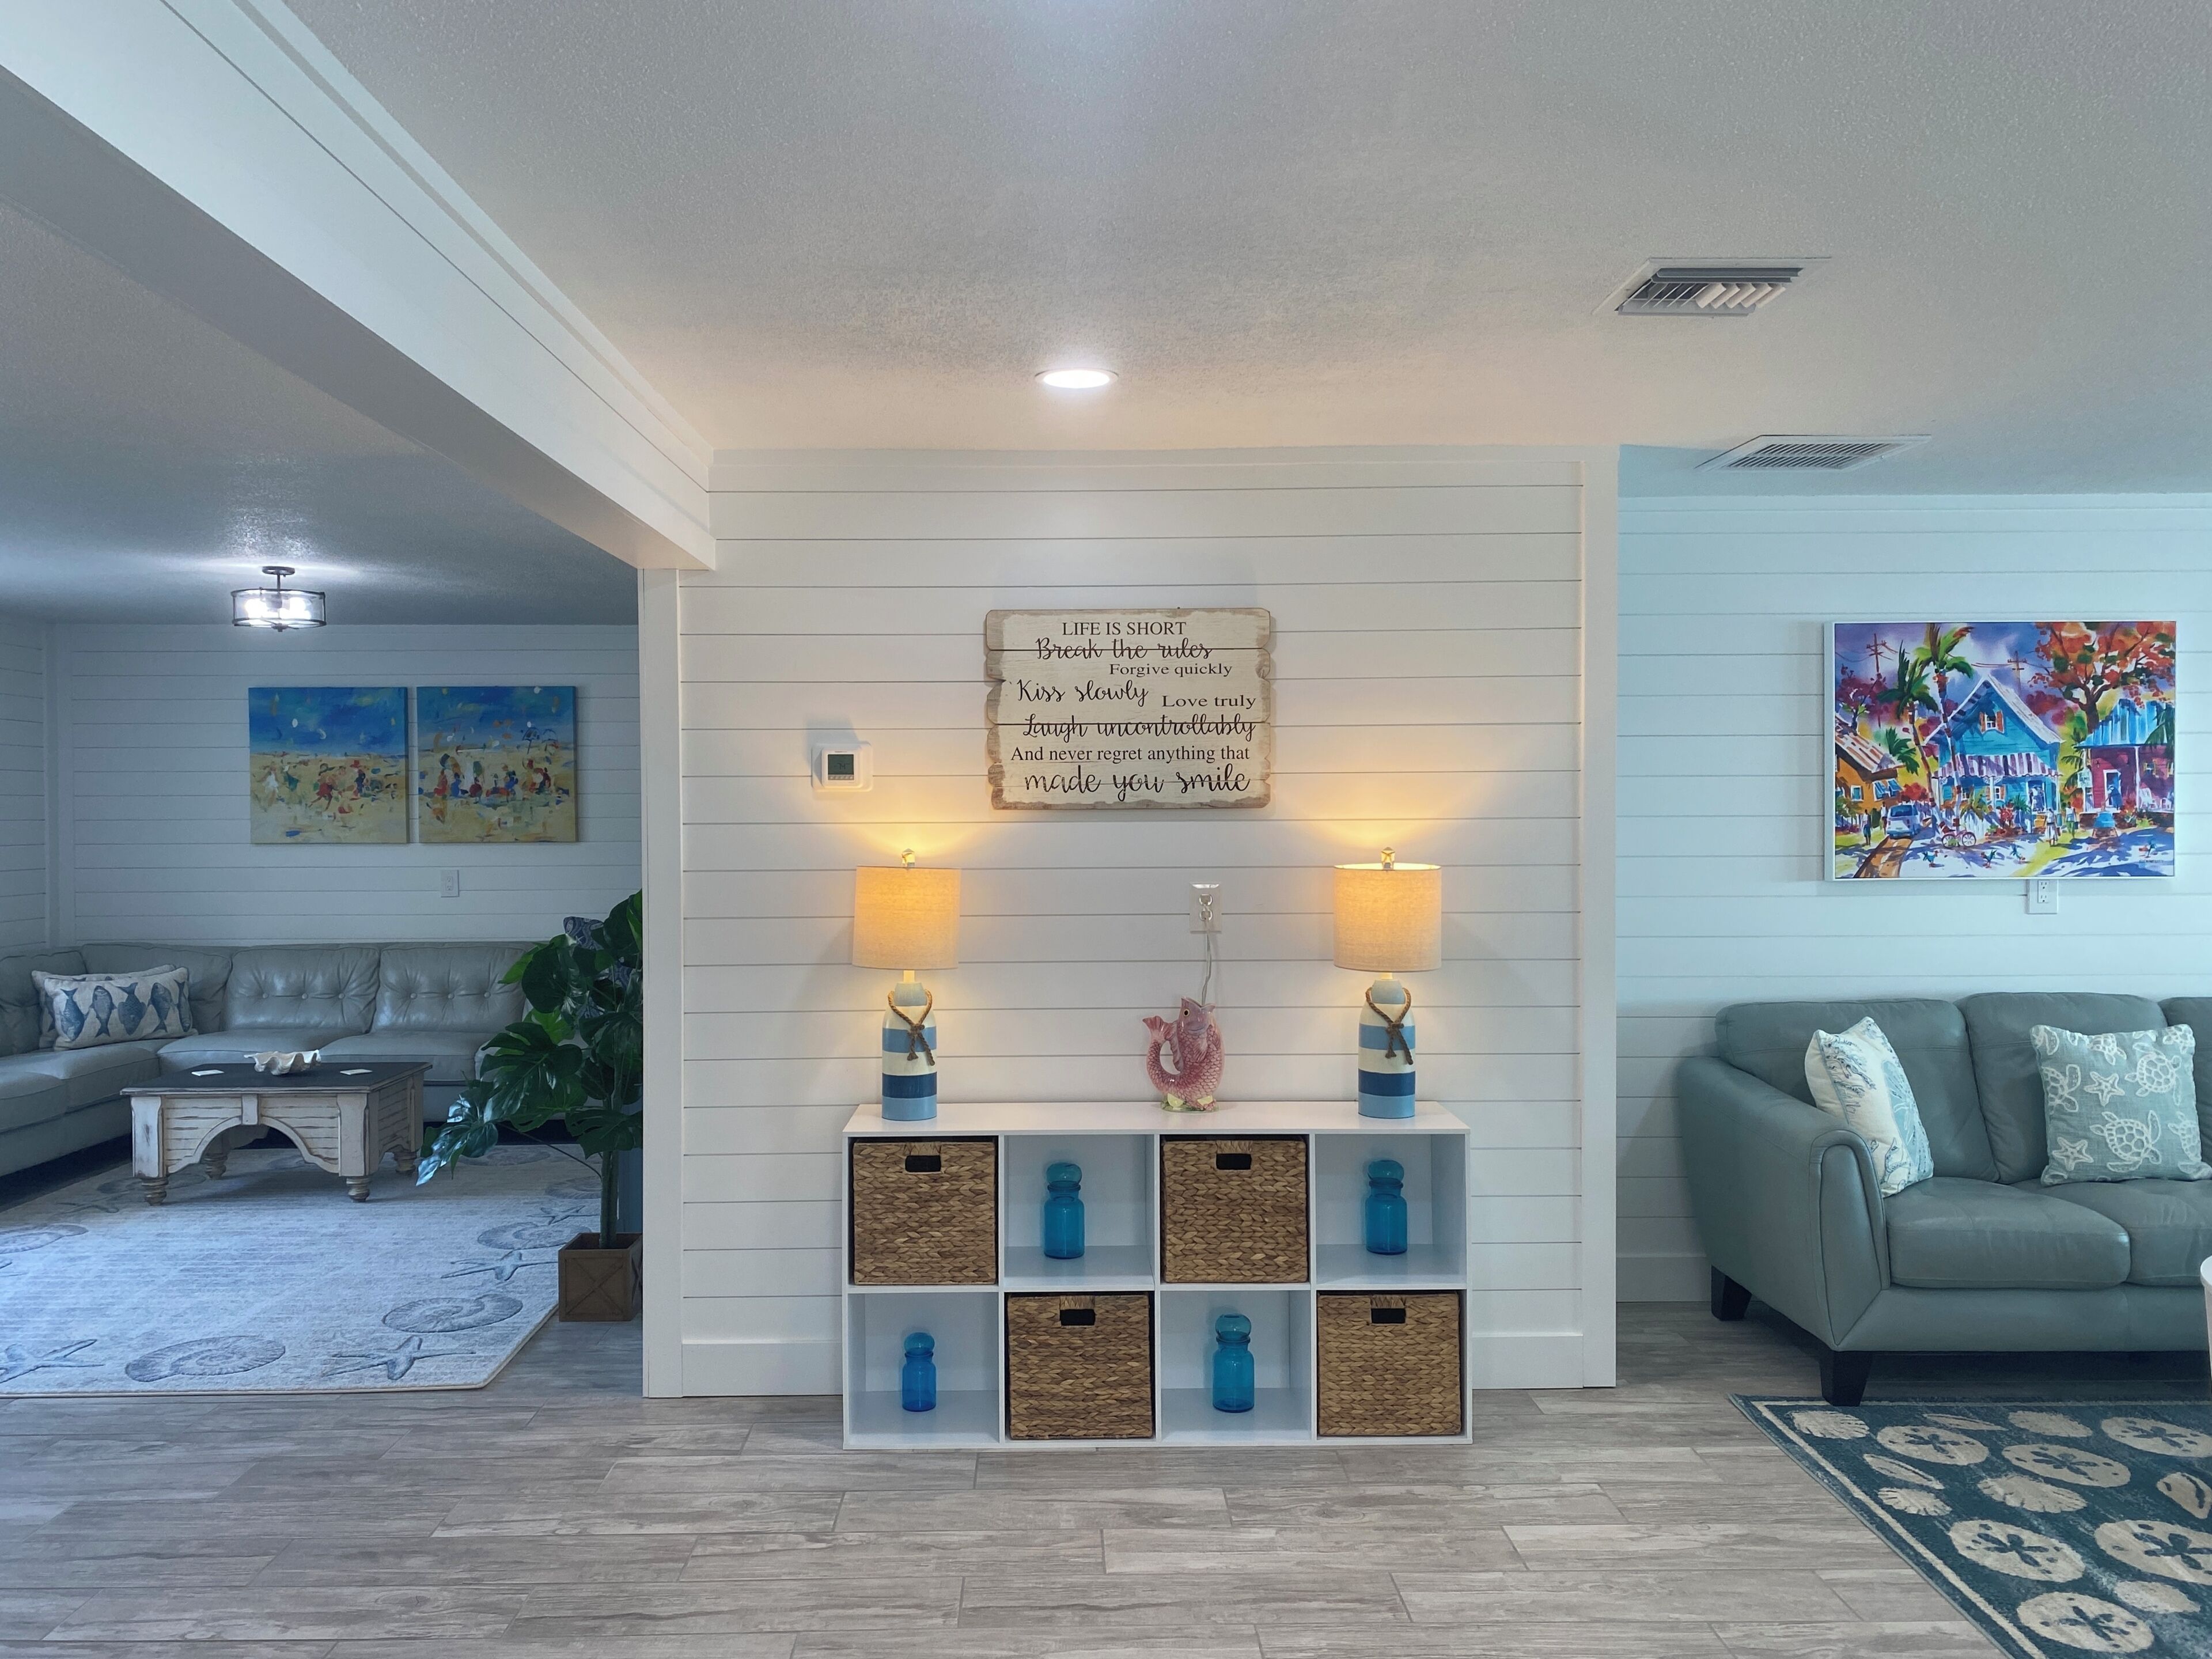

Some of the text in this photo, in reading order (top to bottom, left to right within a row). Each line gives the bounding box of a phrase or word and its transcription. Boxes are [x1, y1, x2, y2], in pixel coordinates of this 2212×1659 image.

[1062, 622, 1187, 635] LIFE IS SHORT
[1036, 638, 1212, 660] Break the rules
[1109, 663, 1232, 677] Forgive quickly
[1017, 679, 1149, 707] Kiss slowly
[1162, 695, 1256, 709] Love truly
[1023, 714, 1256, 743] Laugh uncontrollably
[1011, 746, 1250, 763] And never regret anything that
[1025, 763, 1251, 801] made you smile
